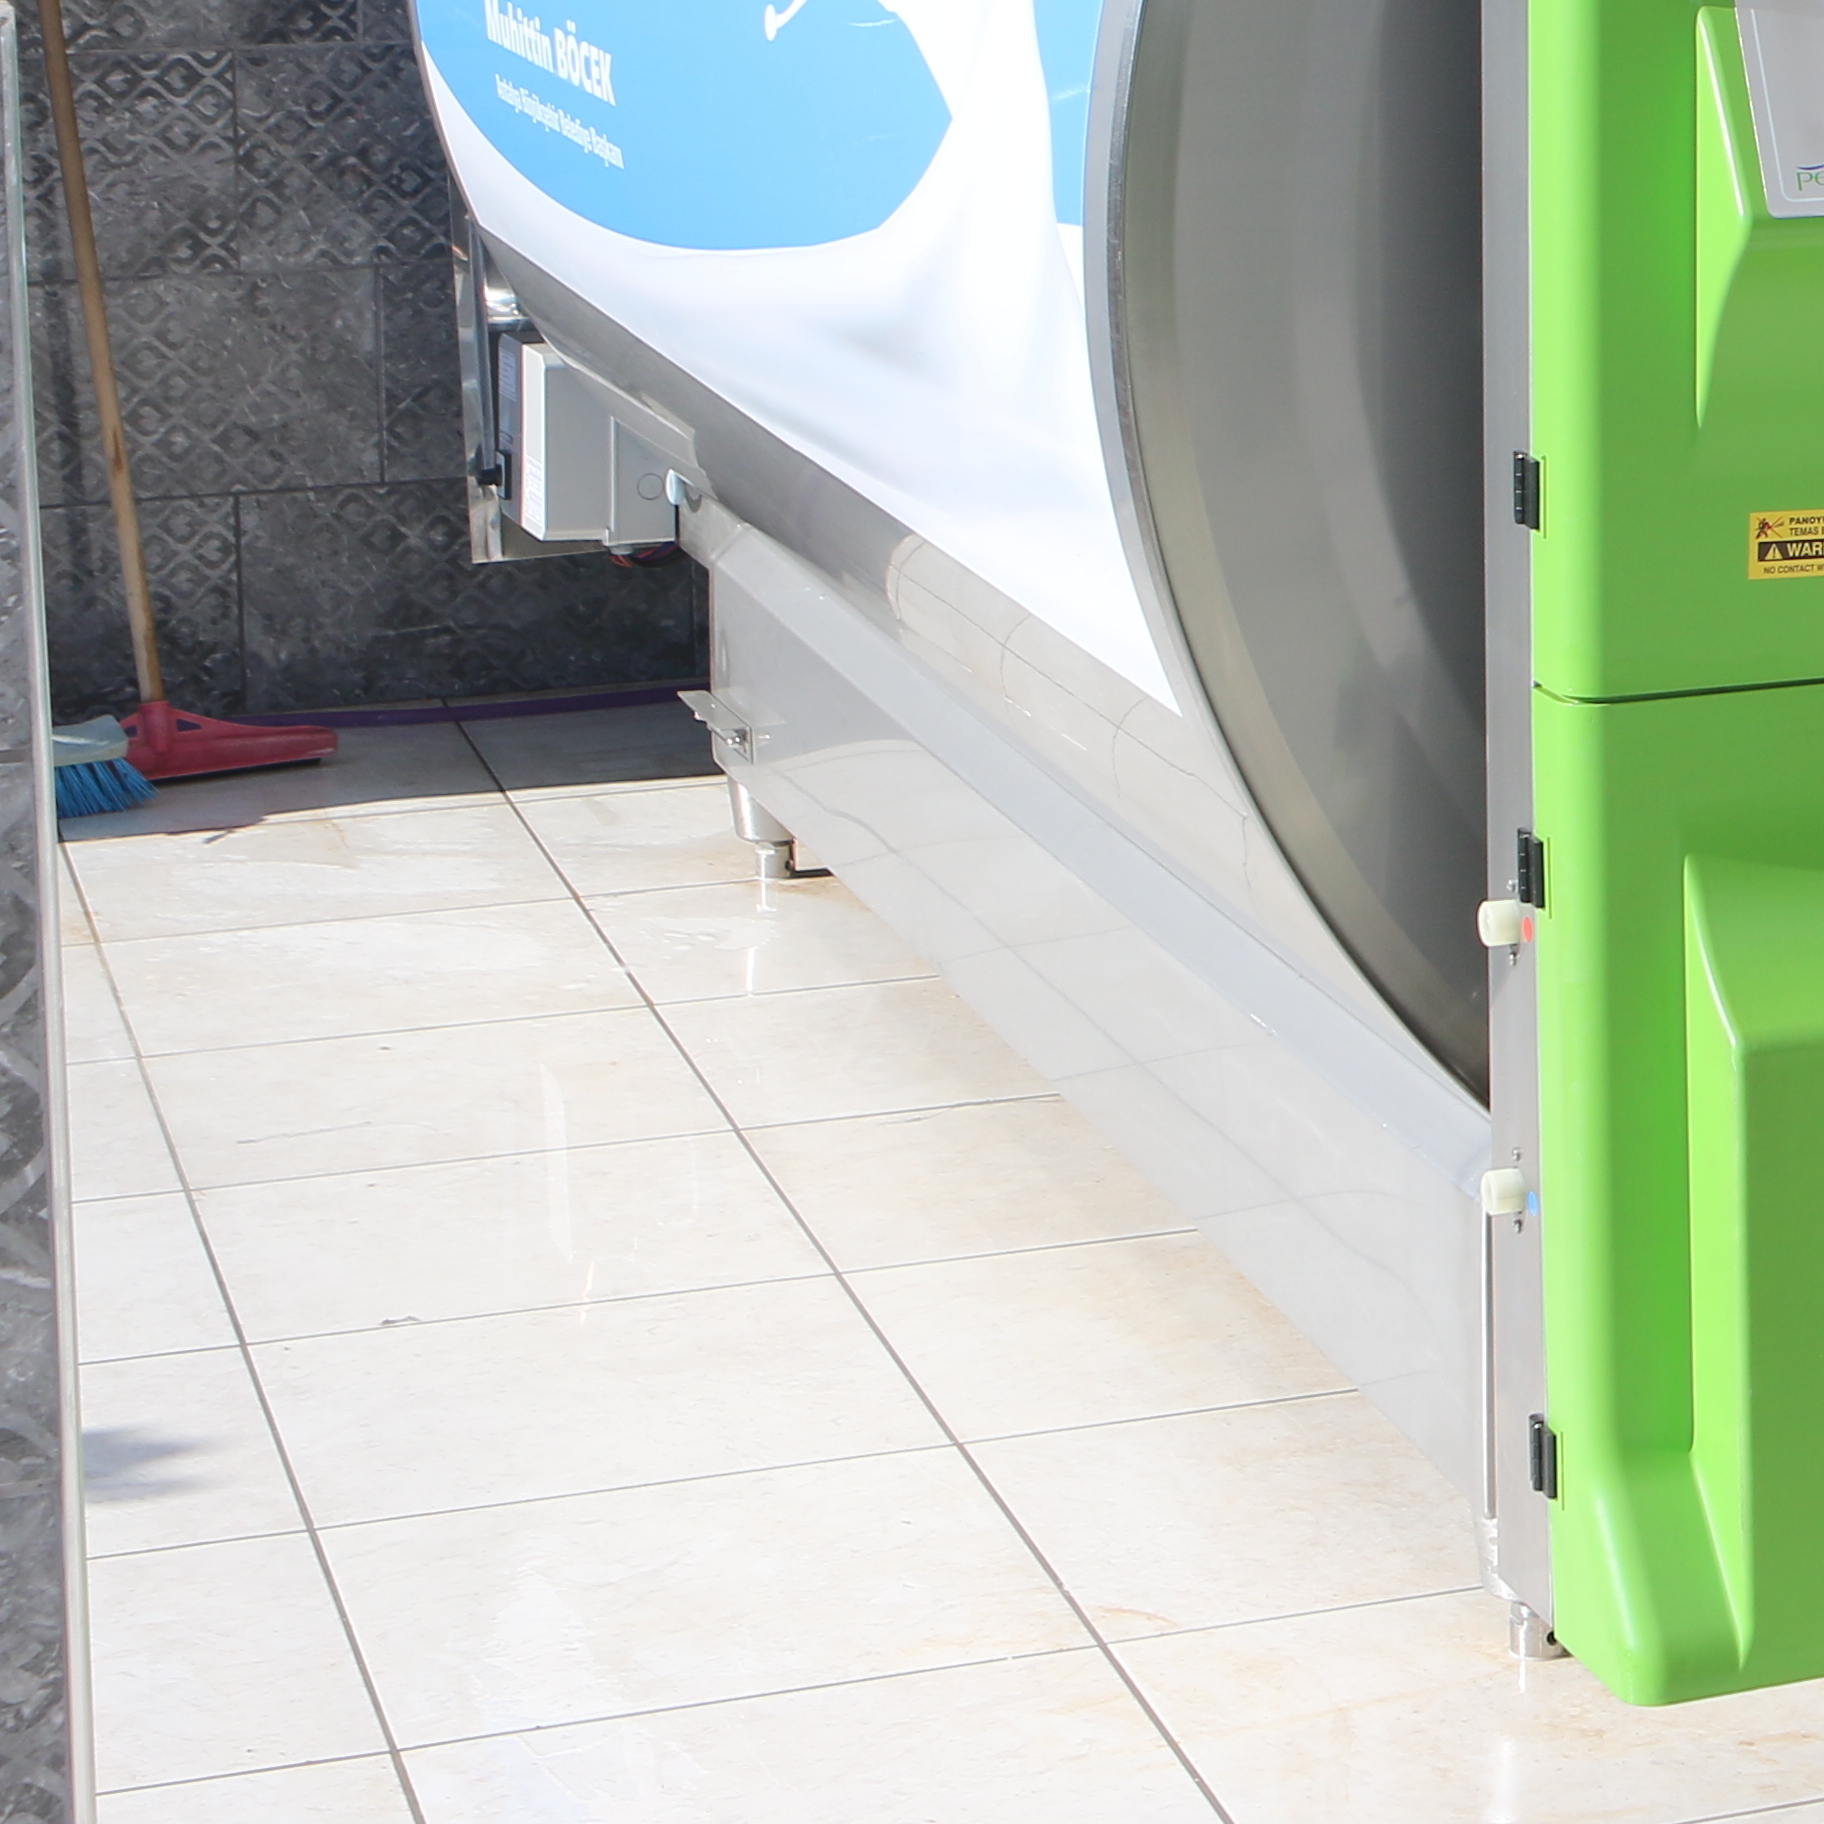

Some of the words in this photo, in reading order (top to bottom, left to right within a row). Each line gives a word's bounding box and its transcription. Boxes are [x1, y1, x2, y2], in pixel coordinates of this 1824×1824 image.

[554, 19, 616, 107] BÖCEK
[1790, 526, 1819, 536] TEMAS
[1763, 565, 1776, 574] NO
[1777, 564, 1814, 574] CONTACT
